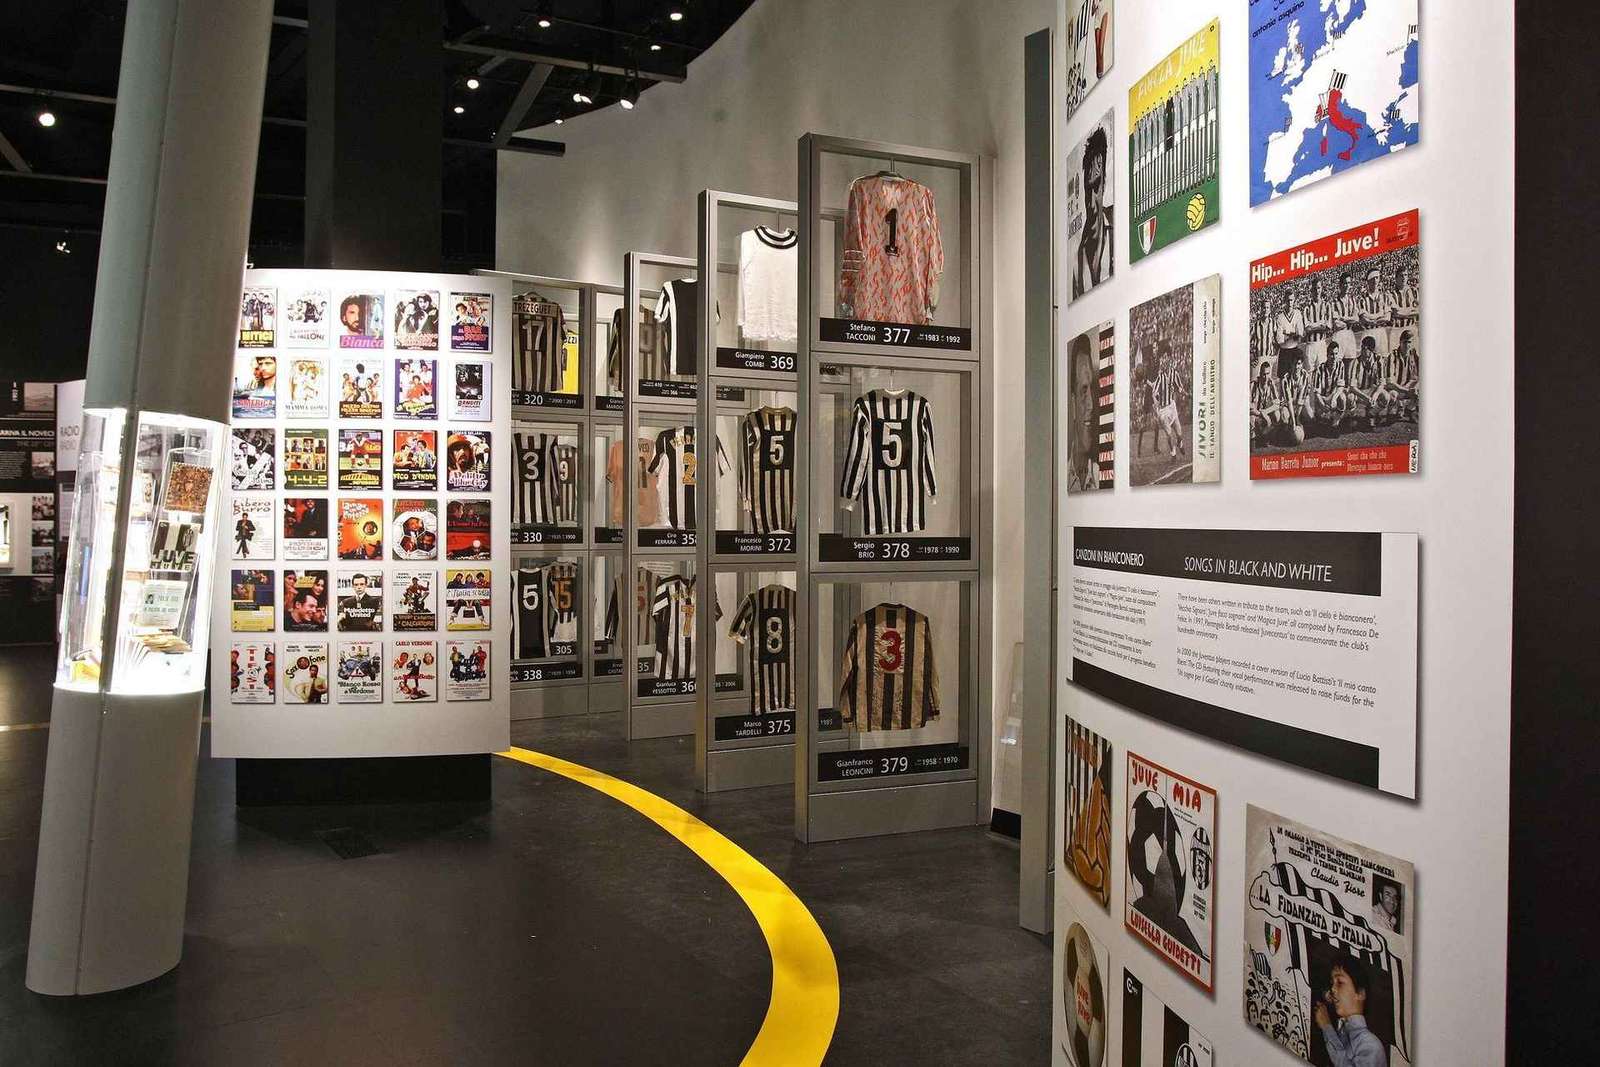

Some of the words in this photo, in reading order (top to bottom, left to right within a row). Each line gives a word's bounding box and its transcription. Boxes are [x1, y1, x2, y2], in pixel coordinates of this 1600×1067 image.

[1252, 20, 1276, 38] antonio
[1279, 2, 1305, 21] asquino
[886, 208, 899, 257] 1
[1251, 263, 1285, 284] Hip...
[1290, 250, 1328, 270] Hip...
[1334, 227, 1380, 258] Juve!
[514, 302, 551, 315] TREZEGUET
[850, 323, 876, 332] Stefano
[340, 336, 384, 348] Bianca
[522, 320, 544, 350] 17
[846, 332, 876, 341] TACCONI
[883, 328, 910, 343] 377
[946, 335, 960, 343] 1992
[735, 352, 764, 361] Giampiero
[771, 355, 793, 370] 369
[745, 360, 764, 368] COMBI
[524, 394, 543, 405] 320
[769, 435, 784, 465] 5
[882, 422, 902, 467] 5
[523, 452, 539, 480] 3
[682, 453, 696, 485] 2
[1321, 460, 1344, 469] presenta:
[287, 475, 327, 484] 4-4-2
[233, 499, 271, 507] Libero
[233, 506, 271, 515] Burro
[523, 532, 542, 543] 330
[735, 537, 761, 545] Francesco
[768, 538, 791, 551] 372
[740, 544, 762, 552] MORINI
[854, 542, 875, 550] Sergio
[882, 543, 909, 558] 378
[858, 551, 875, 559] BRIO
[1076, 548, 1096, 561] CANZONI
[1098, 550, 1103, 562] IN
[1104, 550, 1144, 566] BIANCONERO
[1184, 556, 1212, 573] SONGS
[1215, 558, 1226, 574] IN
[1229, 559, 1259, 577] BLACK
[1261, 561, 1287, 579] AND
[1289, 562, 1332, 582] WHITE
[522, 584, 539, 610] 5
[1221, 599, 1235, 607] written
[1242, 600, 1257, 610] tribute
[1259, 602, 1264, 610] to
[1265, 603, 1273, 612] the
[1290, 606, 1302, 616] such
[1318, 609, 1331, 619] cielo
[680, 604, 694, 636] 7
[1247, 613, 1256, 622] and
[1297, 619, 1325, 633] composed
[1327, 624, 1334, 634] by
[1336, 624, 1366, 637] Francesco
[1368, 628, 1379, 639] De
[766, 616, 783, 653] 8
[1240, 624, 1259, 634] released
[1289, 632, 1294, 640] to
[1296, 633, 1337, 646] commemorate
[1339, 639, 1349, 648] the
[1350, 640, 1369, 651] club's
[555, 645, 572, 655] 305
[879, 630, 902, 671] 3
[523, 669, 542, 681] 338
[1231, 658, 1251, 669] recorded
[1255, 663, 1269, 673] cover
[1270, 666, 1288, 677] version
[1289, 669, 1295, 679] of
[1296, 671, 1310, 681] Lucio
[1344, 680, 1355, 690] mio
[1357, 683, 1376, 694] canto
[1232, 669, 1243, 679] vocal
[1244, 671, 1273, 686] performance
[1275, 680, 1285, 689] was
[1286, 682, 1309, 694] released
[1310, 687, 1316, 695] to
[1317, 689, 1332, 699] raise
[1333, 690, 1350, 704] funds
[1352, 694, 1360, 706] for
[1363, 697, 1374, 708] the
[744, 720, 761, 728] Marco
[768, 720, 791, 734] 375
[736, 728, 762, 736] TARDELLI
[836, 759, 873, 768] Gianfranco
[880, 757, 908, 774] 379
[922, 757, 937, 766] 1958
[943, 756, 958, 764] 1970
[842, 768, 873, 777] LEONCINI
[1132, 760, 1158, 791] JUVE
[1173, 782, 1201, 813] MIA
[1309, 838, 1326, 852] TUTTI
[1311, 867, 1339, 887] Claudio
[1278, 894, 1327, 931] FIDANZATA
[1332, 921, 1372, 949] D'ITALIA
[1131, 910, 1161, 946] LUISELLA
[1163, 934, 1200, 975] GUIDETTI
